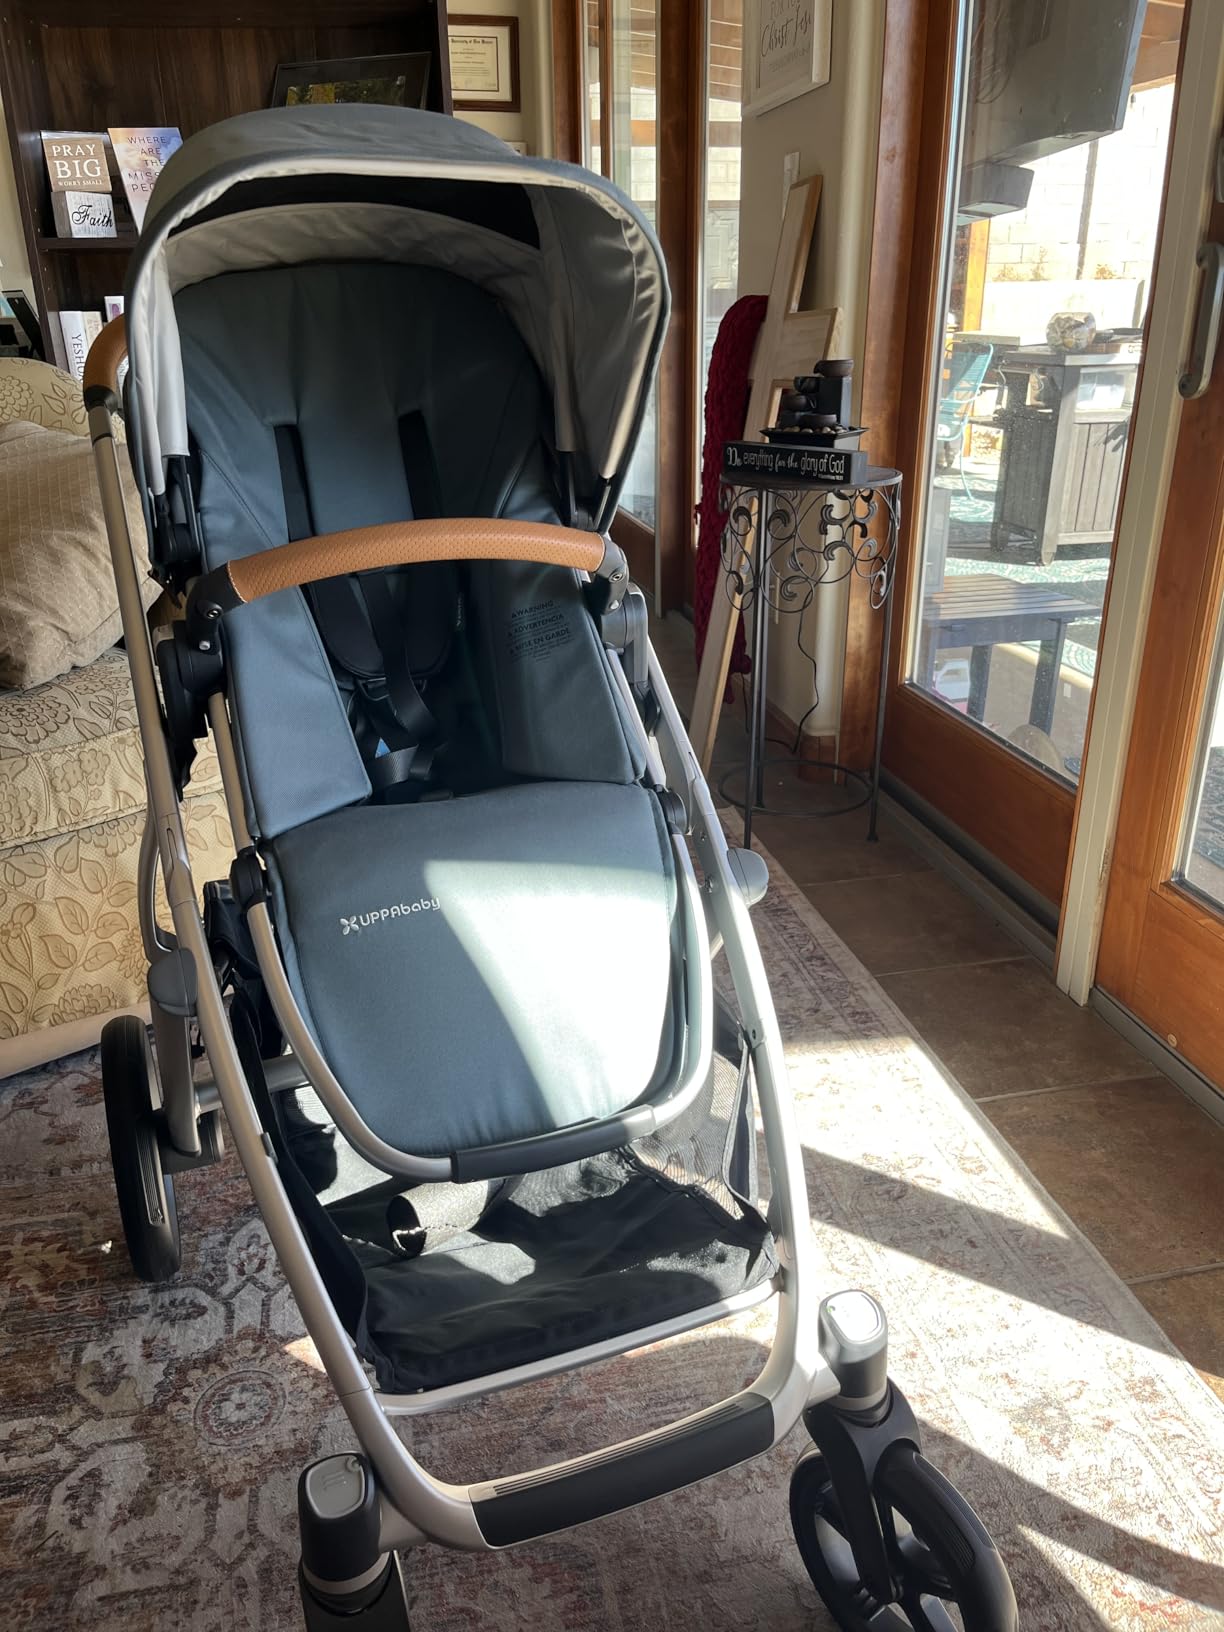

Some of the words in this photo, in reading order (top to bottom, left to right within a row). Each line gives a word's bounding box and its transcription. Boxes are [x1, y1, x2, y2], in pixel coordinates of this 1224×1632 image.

[793, 4, 811, 47] Jes
[127, 136, 167, 144] WHERE
[52, 144, 96, 157] PRAY
[54, 159, 101, 179] BIG
[144, 159, 165, 167] THE
[71, 205, 114, 228] Faith
[743, 449, 774, 471] everything
[774, 453, 786, 472] for
[787, 452, 798, 468] the
[800, 451, 818, 476] glory
[818, 454, 828, 472] of
[828, 454, 845, 474] God
[516, 600, 554, 616] WARNING
[359, 897, 441, 926] UPPAbaby
